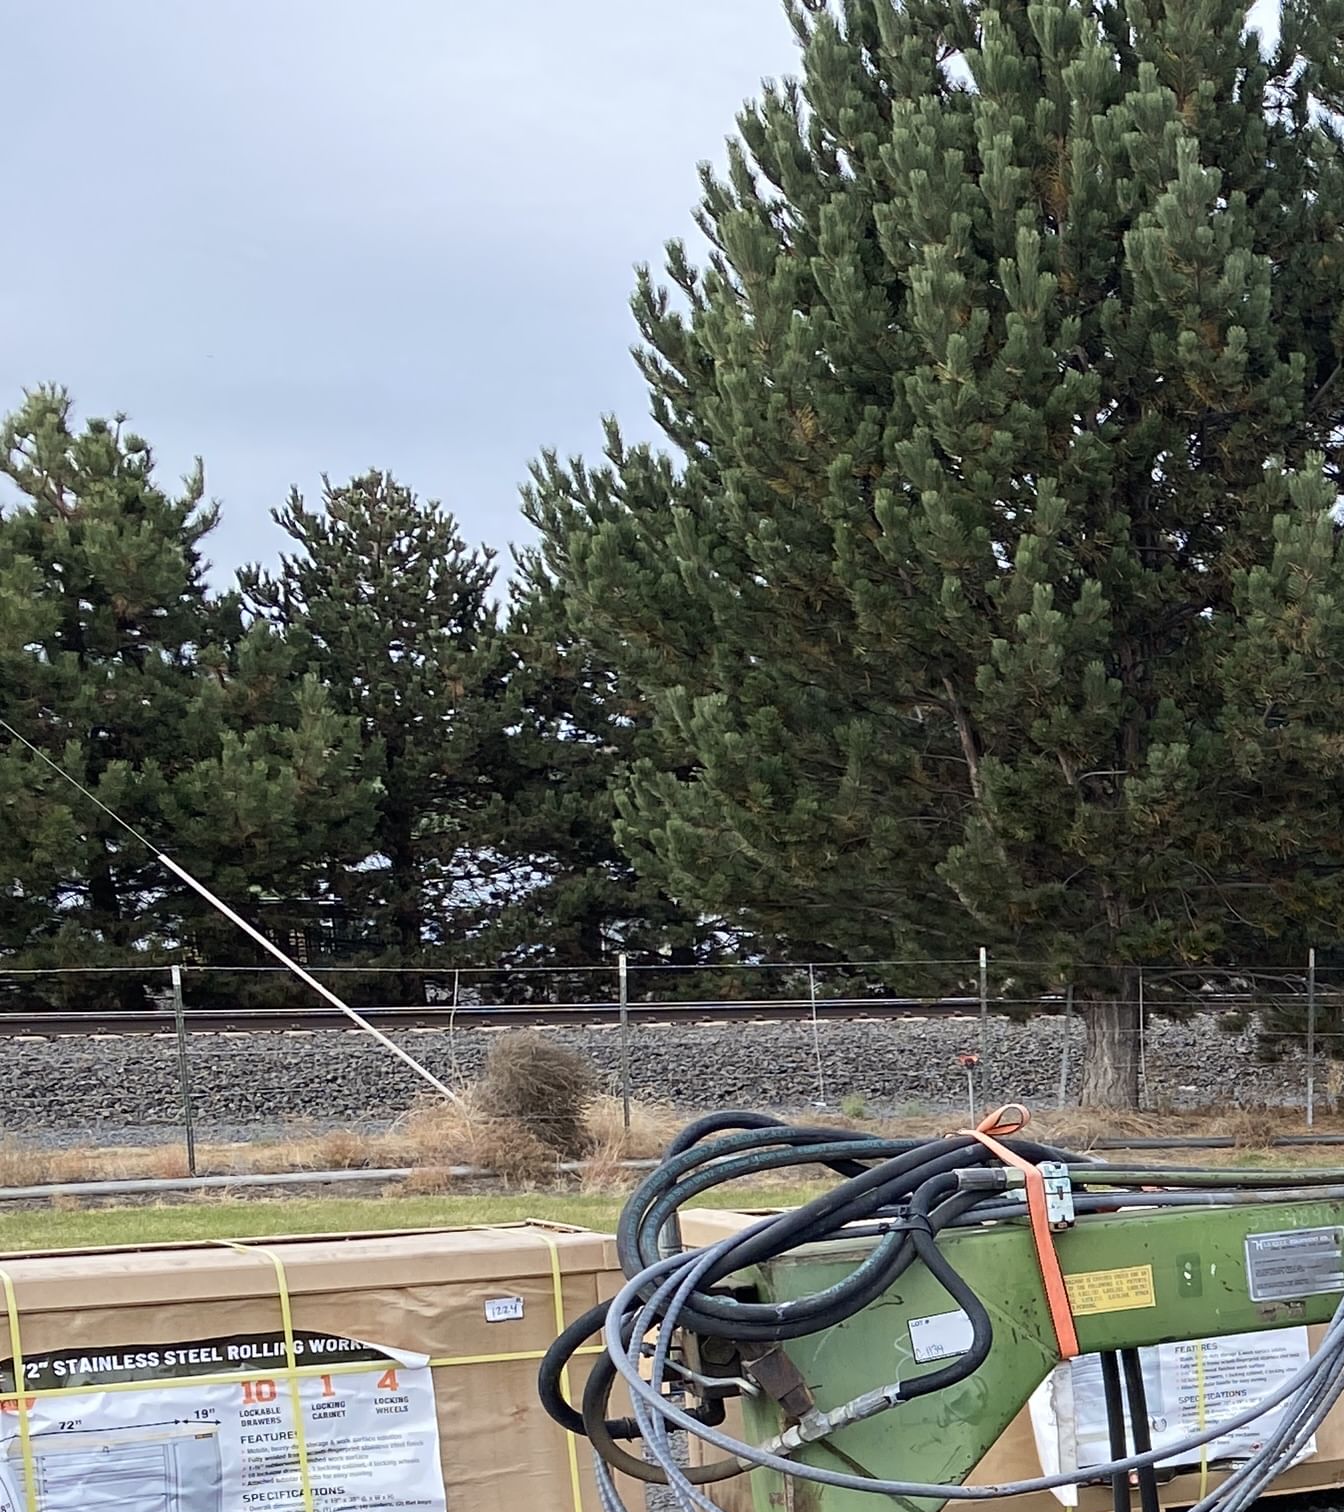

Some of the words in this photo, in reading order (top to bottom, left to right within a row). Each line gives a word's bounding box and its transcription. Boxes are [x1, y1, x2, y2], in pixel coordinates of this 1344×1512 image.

[492, 1303, 518, 1318] 1224
[53, 1351, 160, 1377] STAINLESS
[164, 1347, 224, 1365] STEEL
[227, 1339, 304, 1361] ROLLING
[308, 1338, 376, 1352] WORK
[240, 1379, 277, 1405] 10
[320, 1374, 335, 1397] 1
[377, 1368, 399, 1392] 4
[374, 1396, 409, 1405] LOCKING
[1178, 1389, 1247, 1404] SPECFICATIONS
[311, 1401, 346, 1411] LOCKING
[376, 1405, 409, 1414] WHEELS
[239, 1407, 281, 1418] LOCKABLE
[312, 1410, 346, 1420] CABINET
[58, 1419, 82, 1430] 72"
[241, 1417, 282, 1427] DRAWERS
